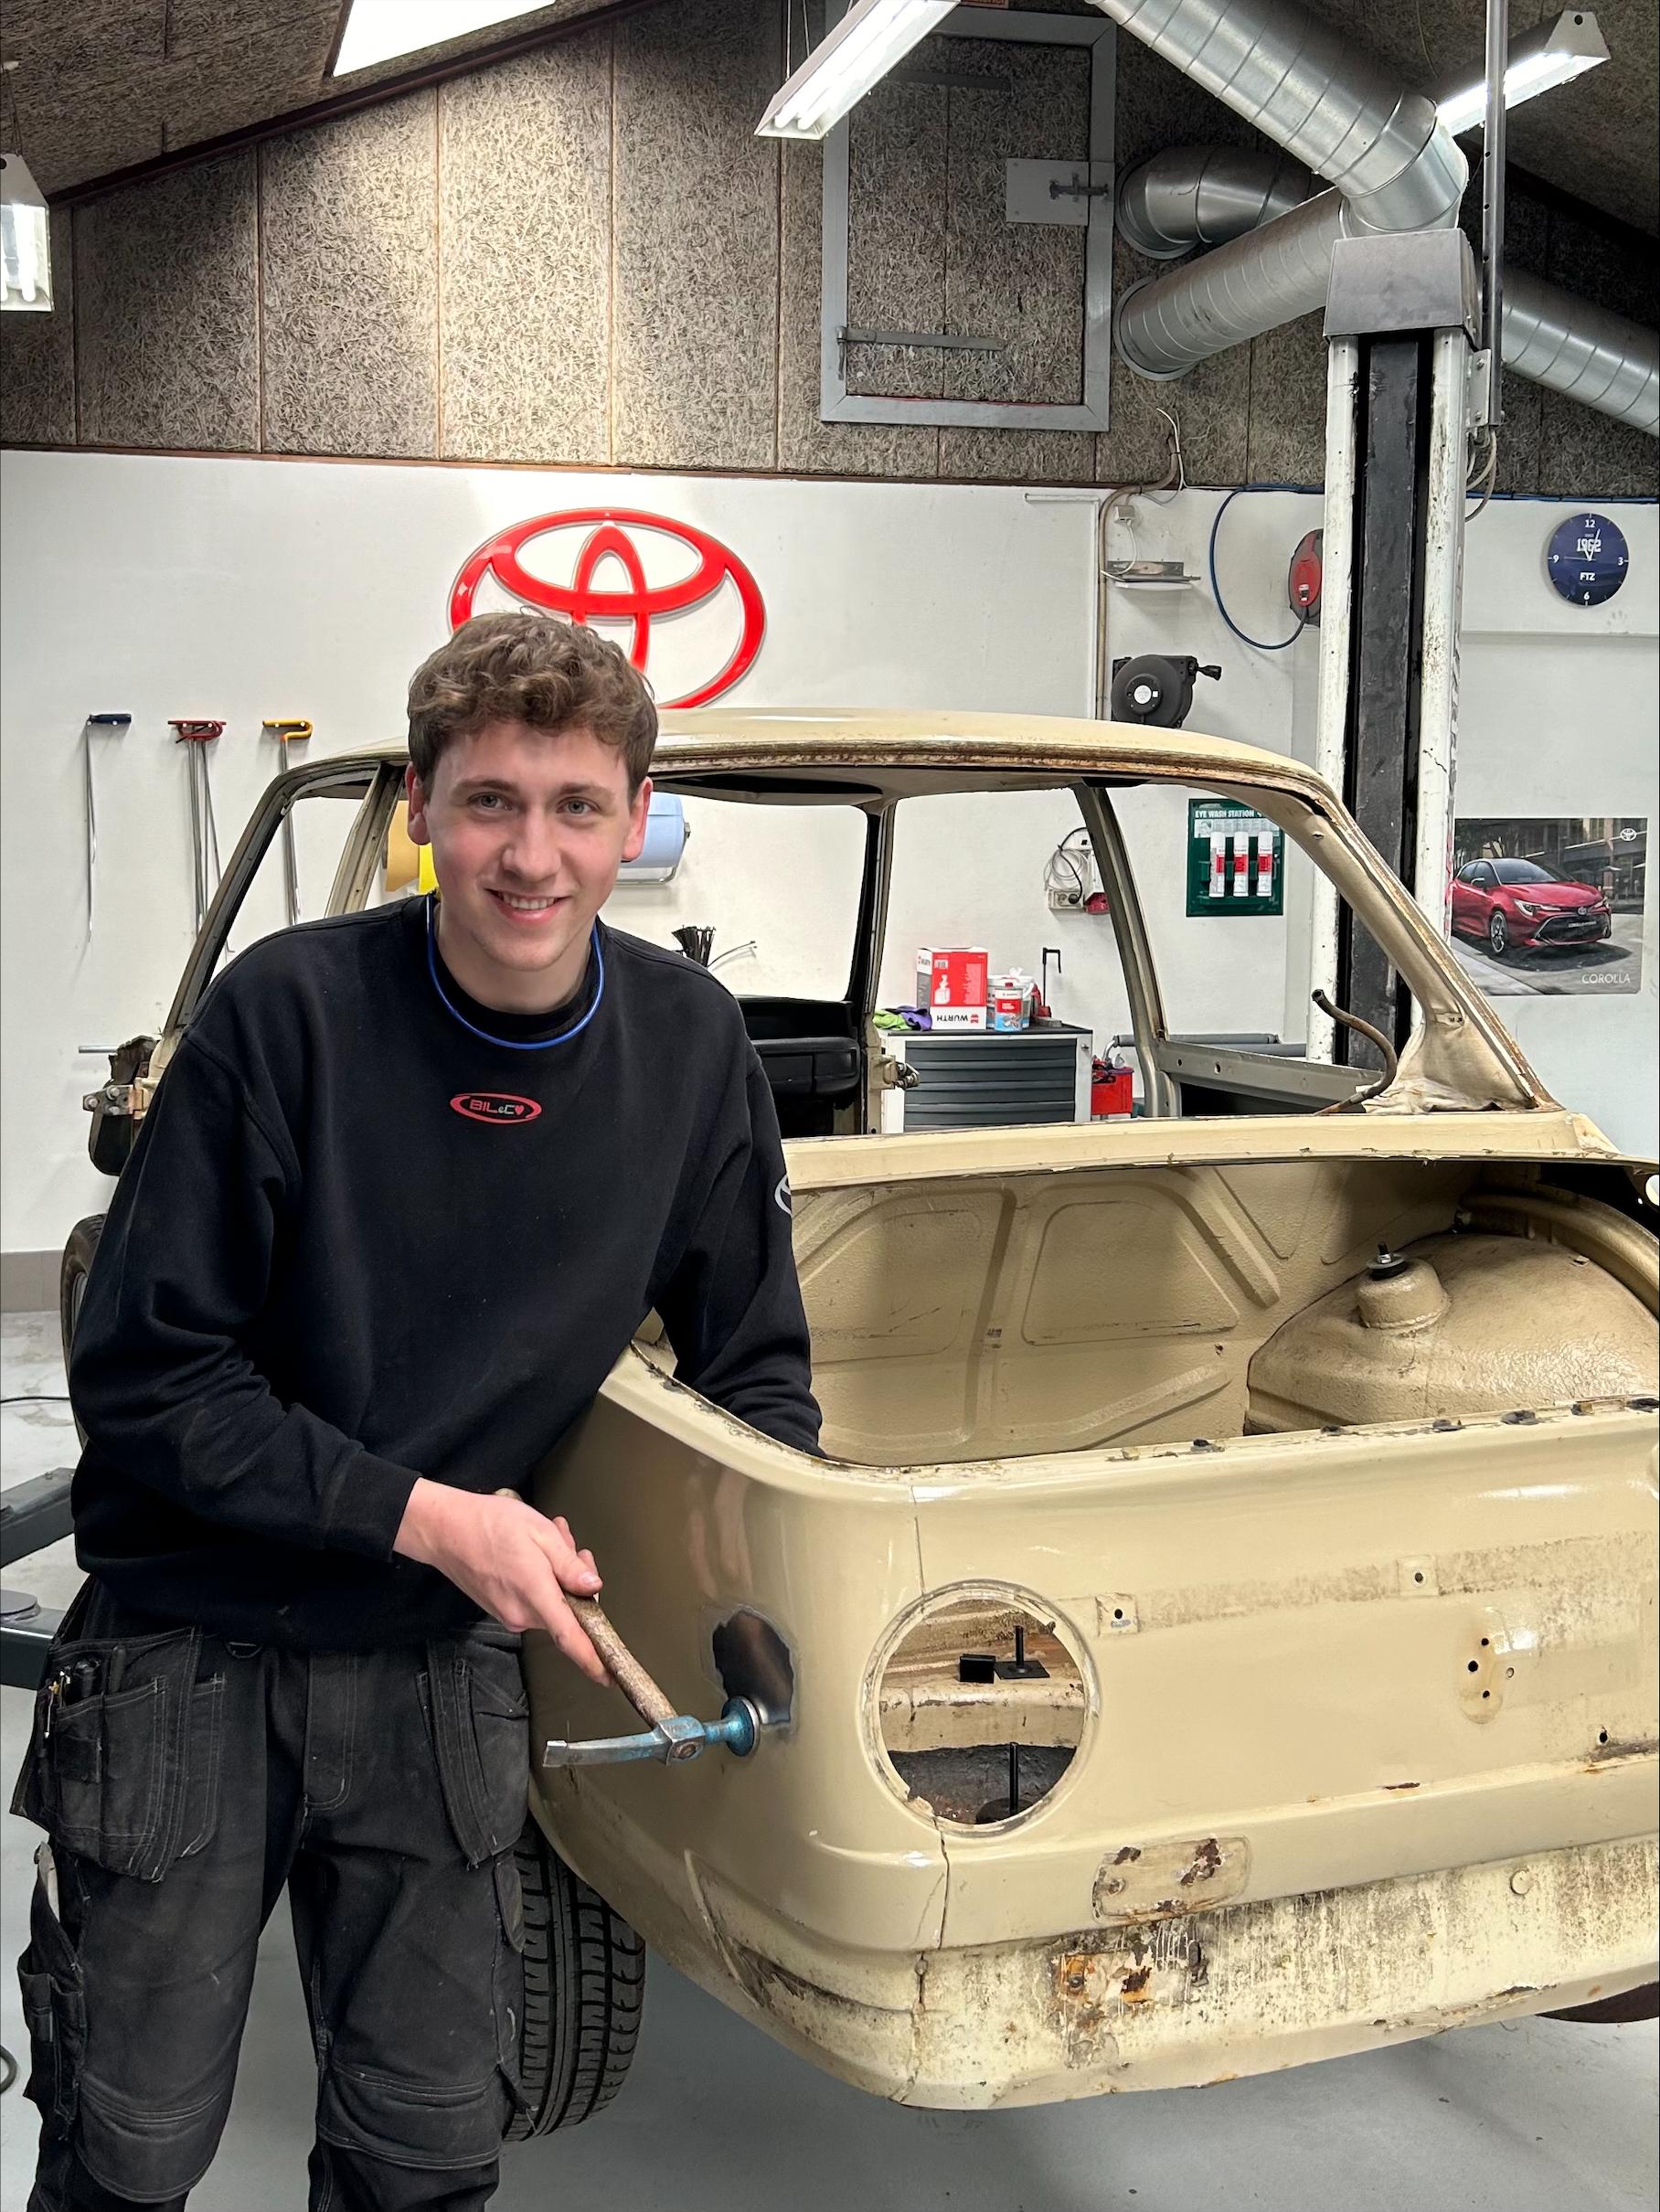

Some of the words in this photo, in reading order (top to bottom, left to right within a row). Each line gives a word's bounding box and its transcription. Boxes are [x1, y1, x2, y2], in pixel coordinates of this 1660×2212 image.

[1585, 519, 1596, 528] 12
[1577, 538, 1601, 552] 1962
[1553, 555, 1559, 563] 9
[1618, 557, 1624, 566] 3
[1580, 572, 1596, 581] FTZ
[1584, 592, 1591, 601] 6
[1228, 810, 1254, 818] STATION
[1582, 973, 1631, 984] COROLLA
